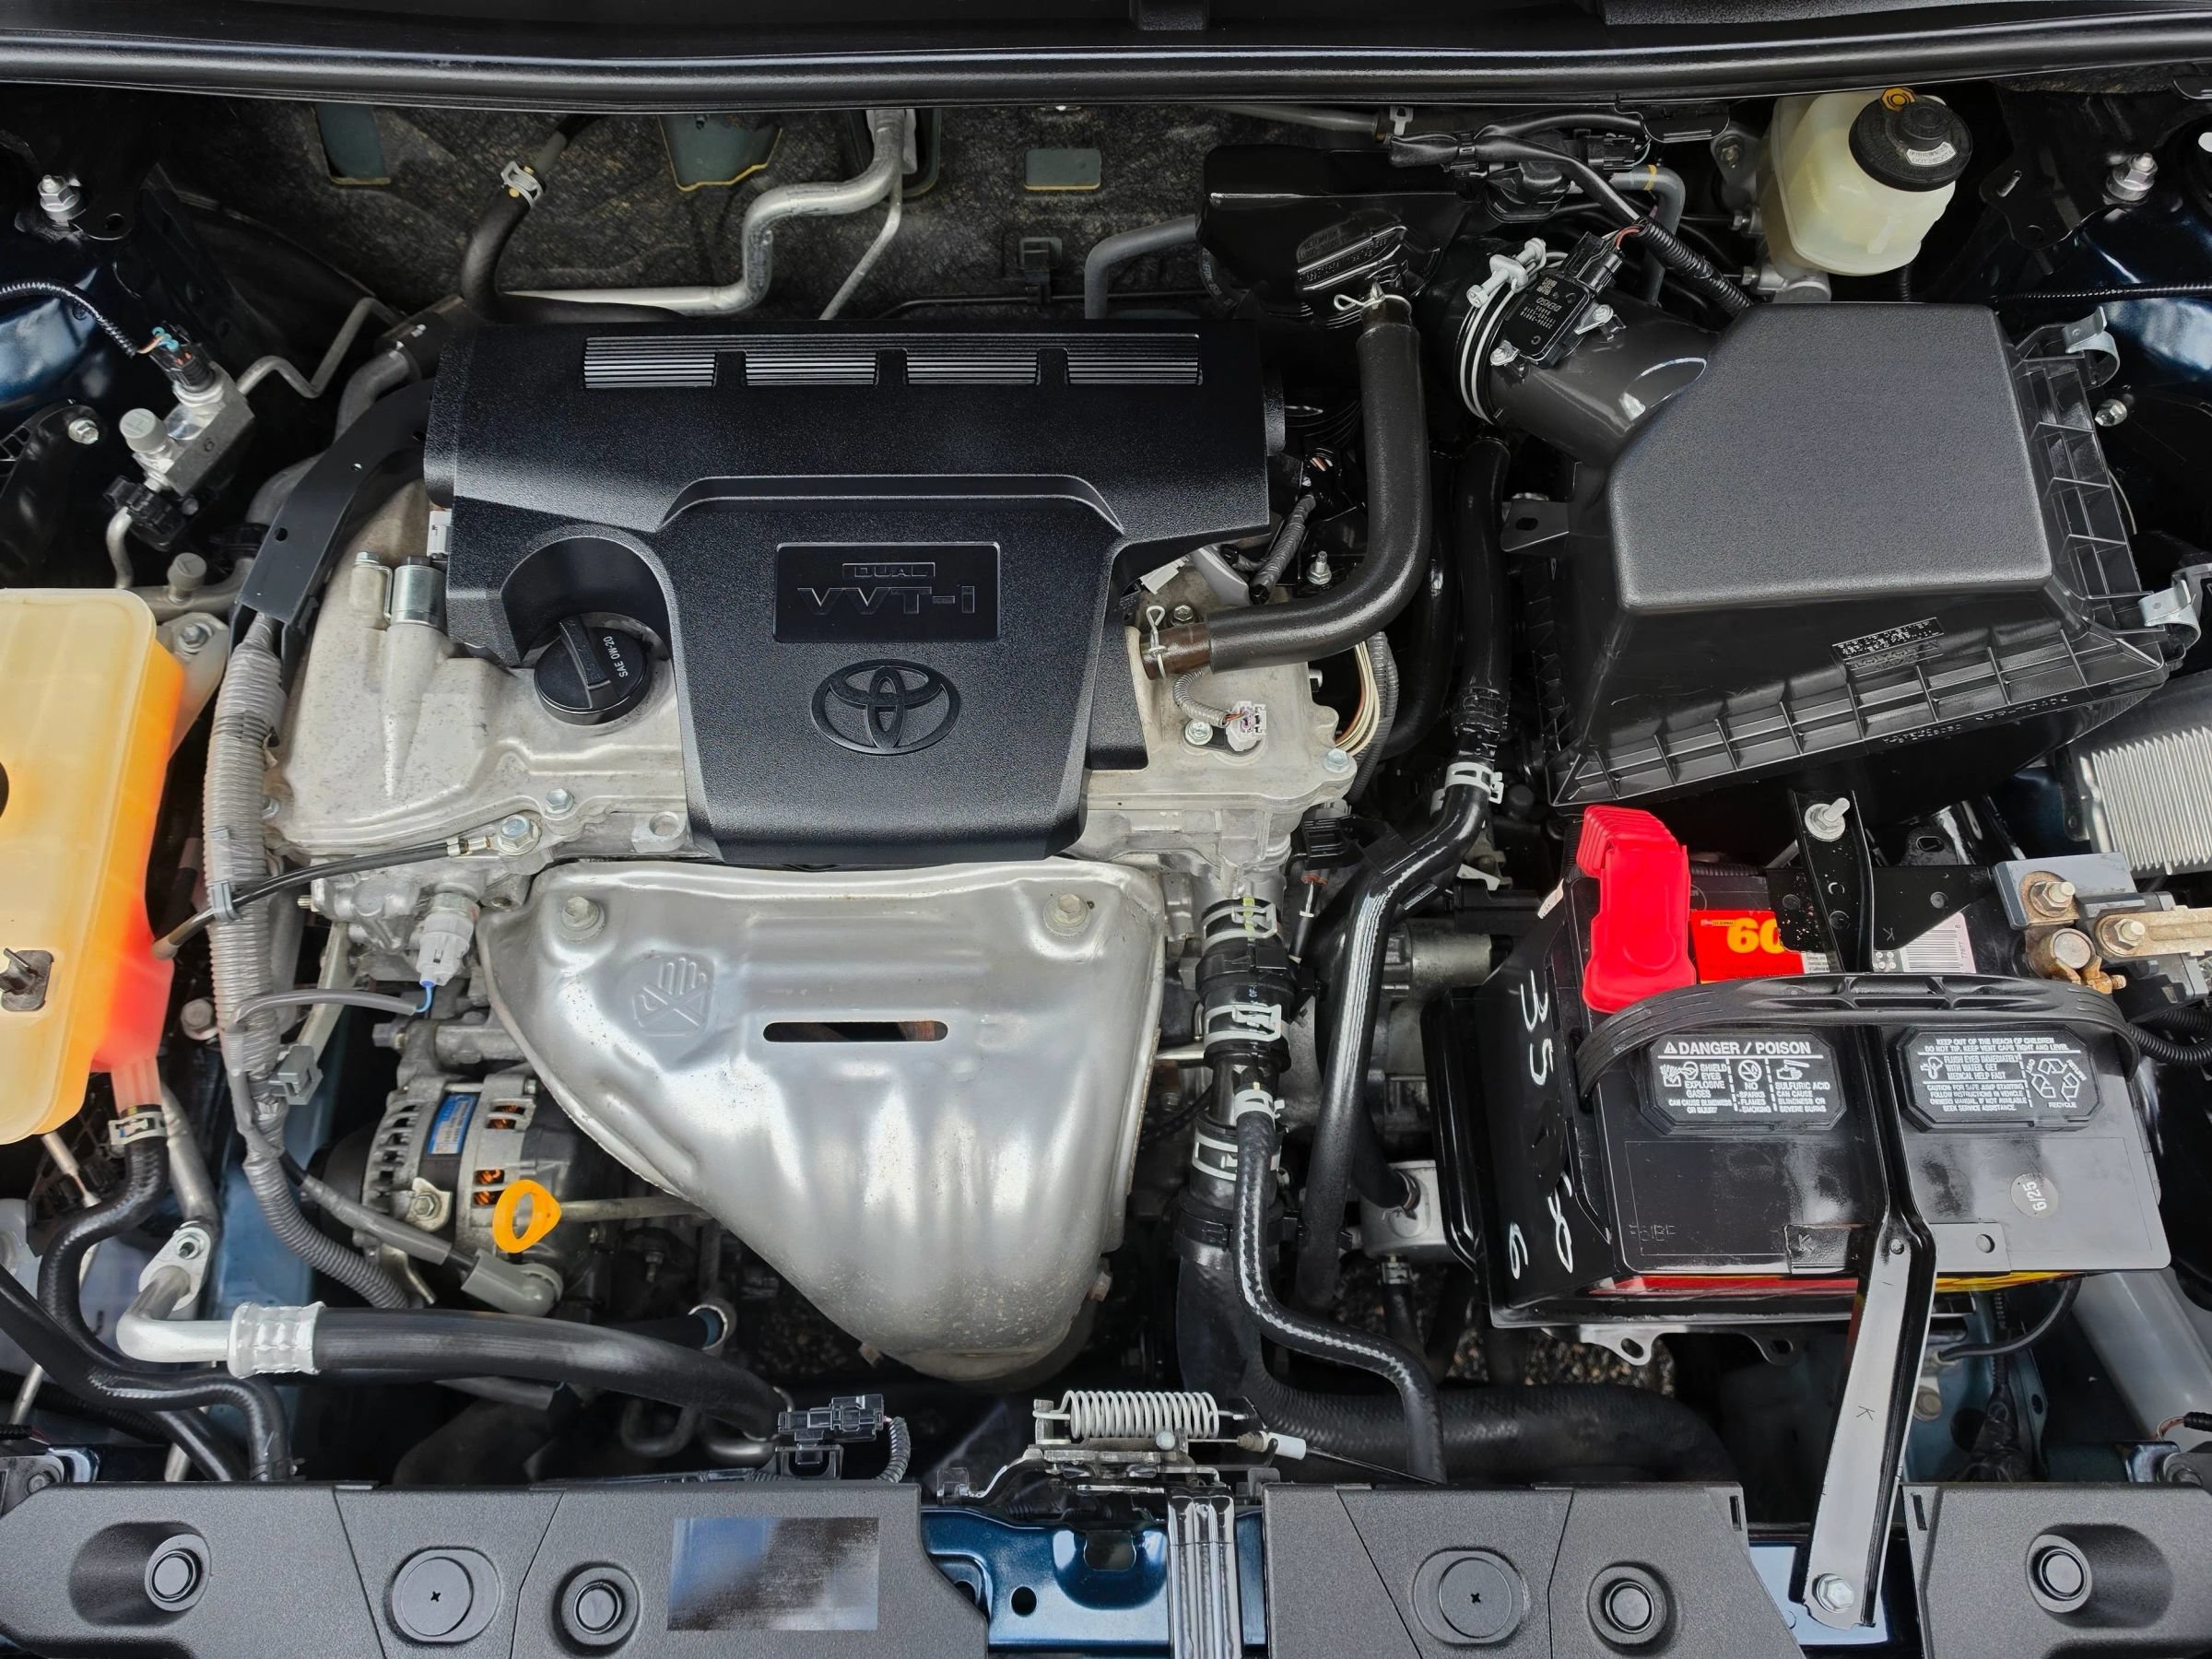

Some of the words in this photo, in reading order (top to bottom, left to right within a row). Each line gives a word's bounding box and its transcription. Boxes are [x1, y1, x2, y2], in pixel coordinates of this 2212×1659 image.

[853, 564, 928, 578] DUAL
[614, 661, 629, 677] SAE
[1678, 1041, 1741, 1054] DANGER
[1756, 1041, 1812, 1054] POISON
[1943, 1055, 1963, 1064] FLUSH
[1980, 1054, 2019, 1063] IMMEDIATELY
[1700, 1064, 1727, 1072] SHIELD
[1984, 1063, 1997, 1071] GET
[1700, 1072, 1722, 1080] EYES
[1991, 1071, 2006, 1079] FAST
[1684, 1080, 1725, 1088] EXPLOSIVE
[1744, 1082, 1759, 1090] NO
[1812, 1081, 1830, 1089] ACID
[1686, 1089, 1712, 1098] GASES
[2022, 1182, 2047, 1211] 6/25
